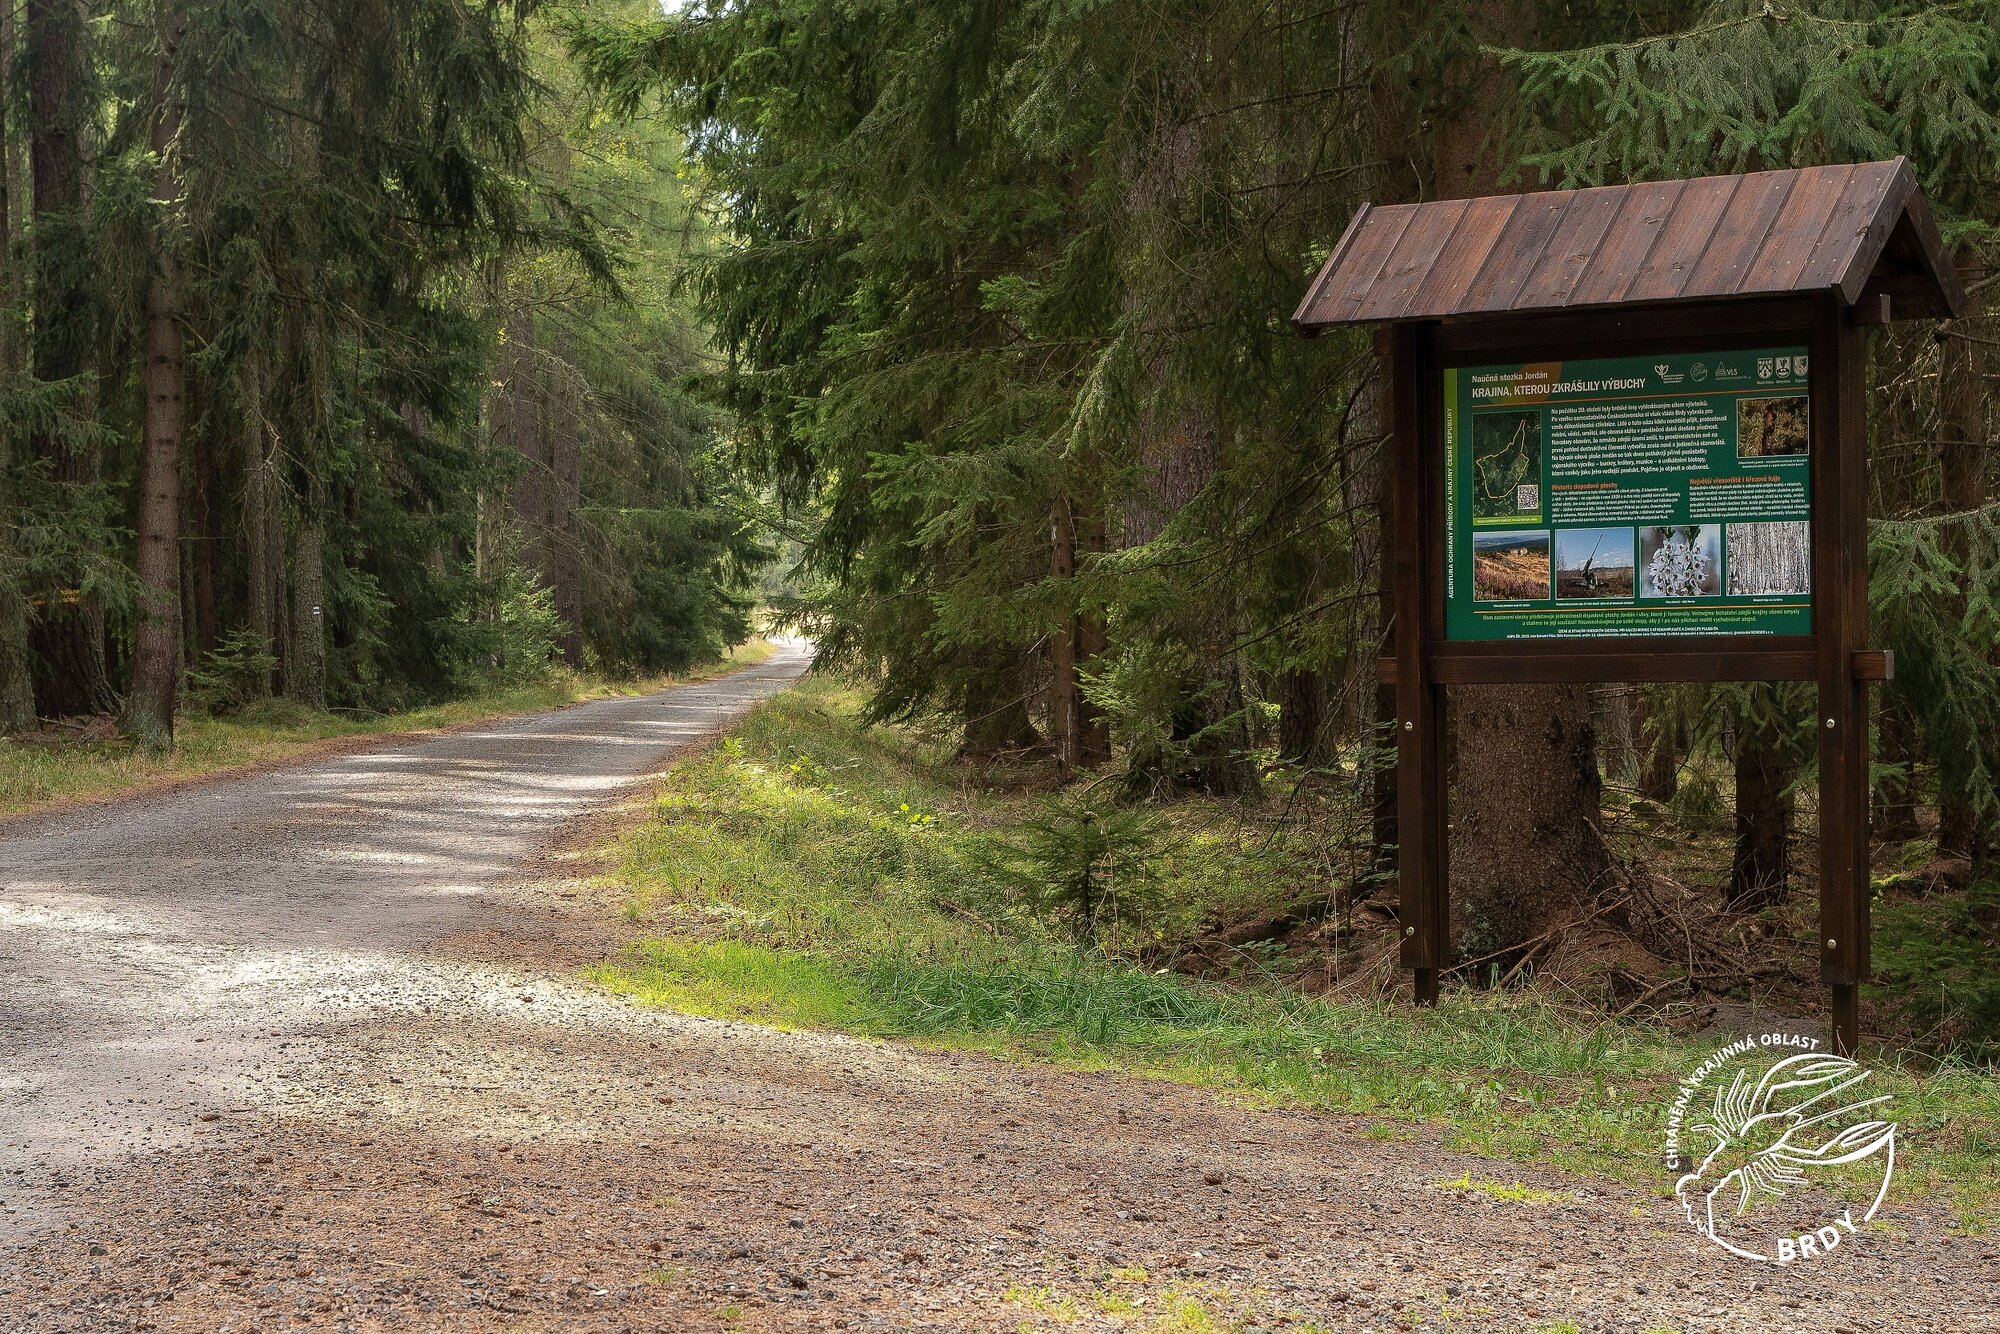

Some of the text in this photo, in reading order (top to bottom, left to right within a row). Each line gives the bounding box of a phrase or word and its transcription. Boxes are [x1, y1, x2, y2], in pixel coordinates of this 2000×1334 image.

[1472, 374, 1498, 383] Naučná
[1525, 372, 1548, 380] Jordán
[1472, 378, 1646, 398] KRAJINA, KTEROU ZKRÁŠLILY VÝBUCHY
